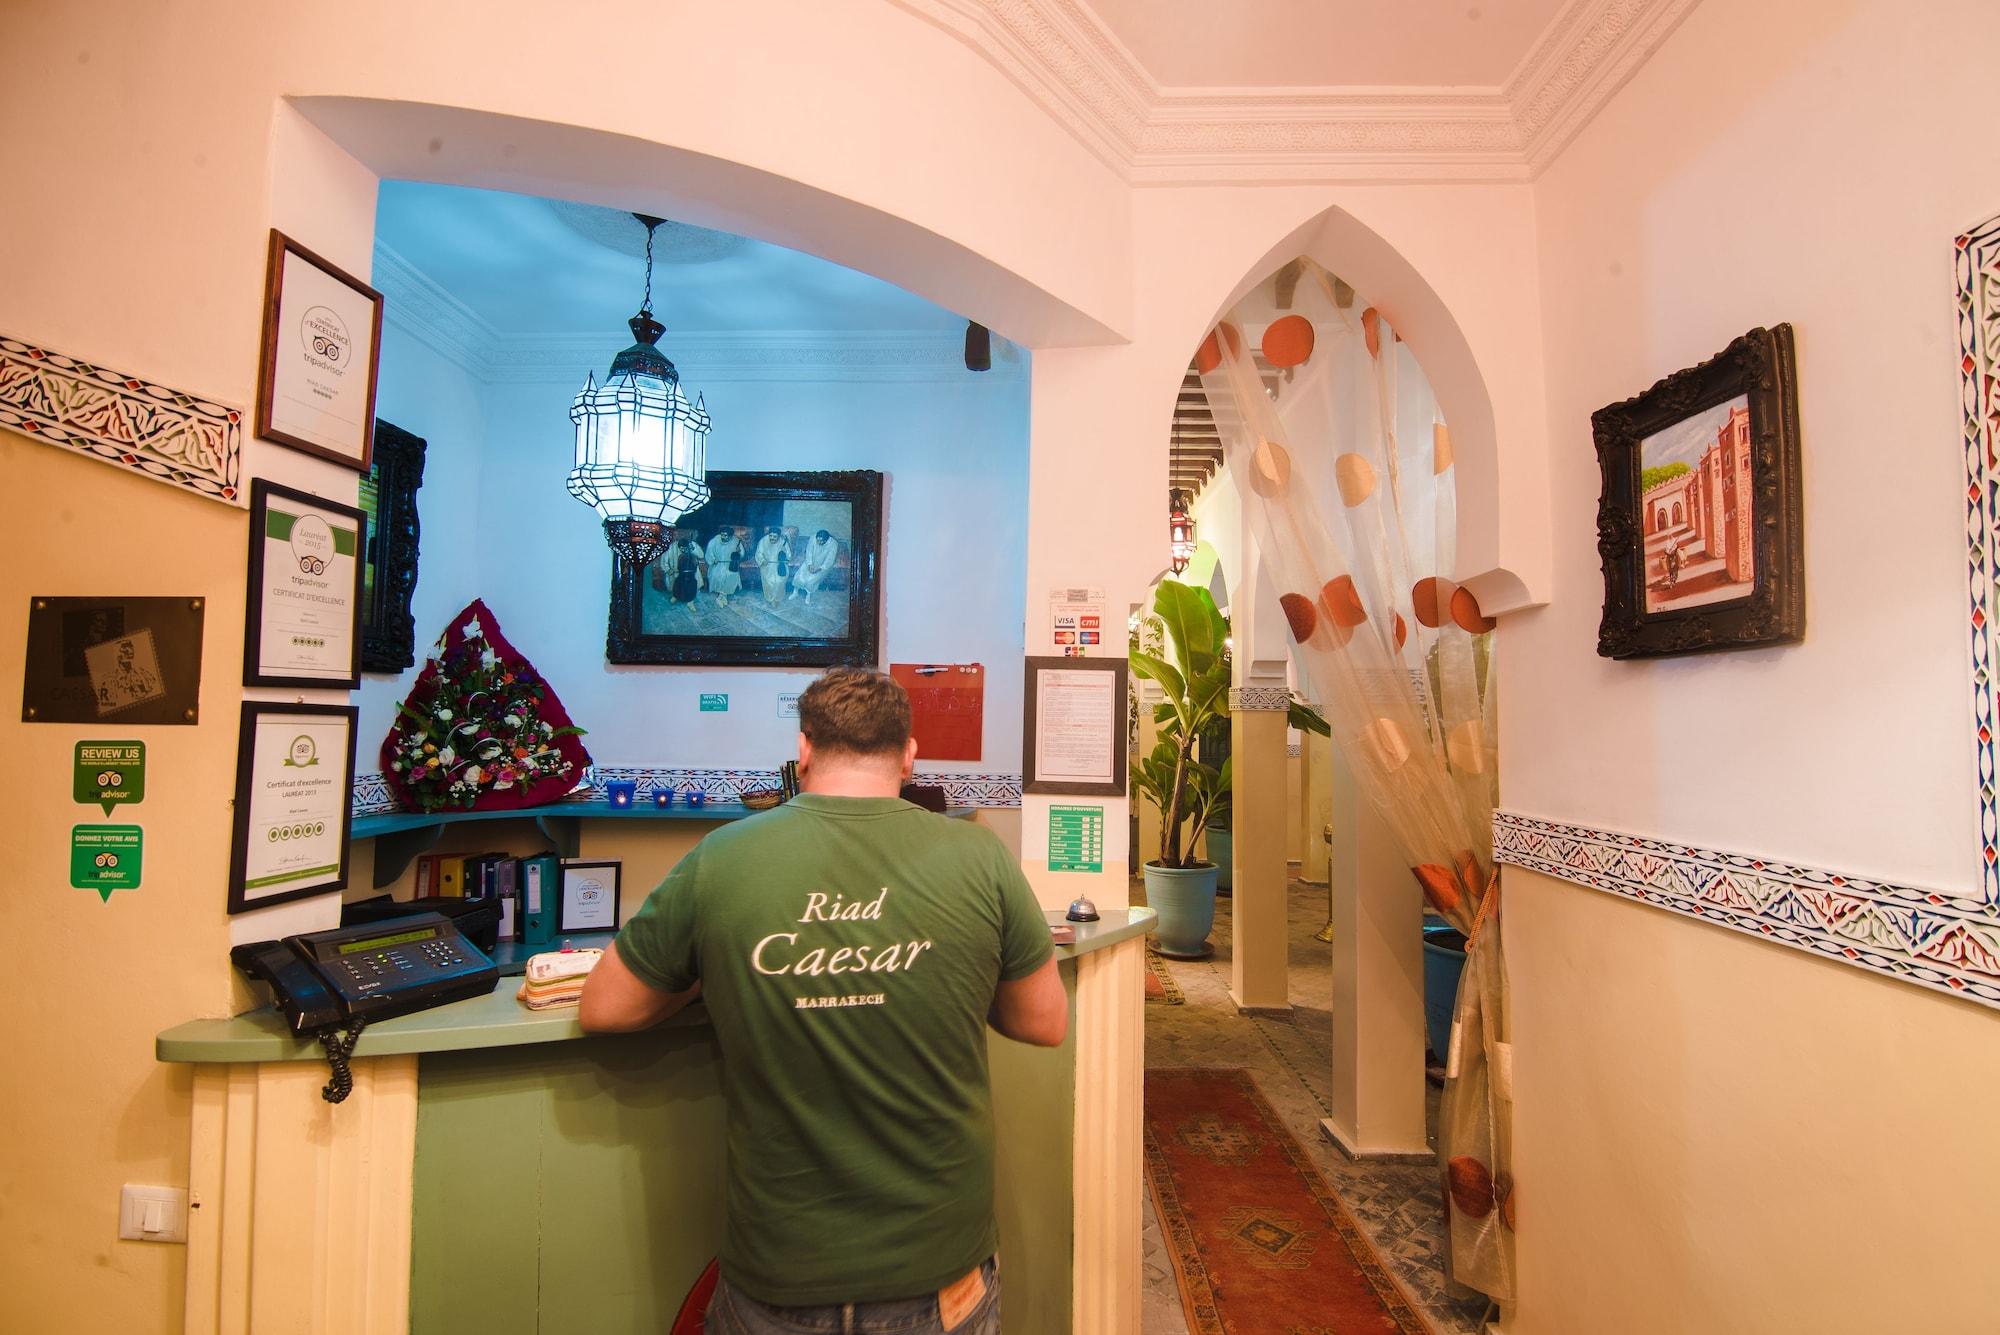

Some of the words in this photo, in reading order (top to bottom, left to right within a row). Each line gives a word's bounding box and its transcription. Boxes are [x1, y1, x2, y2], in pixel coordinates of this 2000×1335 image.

[304, 352, 344, 378] tripadvisor
[292, 575, 328, 590] tripadvisor
[273, 588, 306, 600] CERTIFICAT
[1081, 618, 1099, 628] cmi
[82, 749, 122, 758] REVIEW
[125, 749, 140, 758] US
[266, 780, 296, 789] Certificat
[296, 778, 332, 788] d'excellence
[88, 790, 129, 799] tripadvisor
[88, 870, 126, 879] tripadvisor
[797, 888, 888, 922] Riad
[752, 932, 932, 976] Caesar
[795, 994, 884, 1008] MARRAKECH
